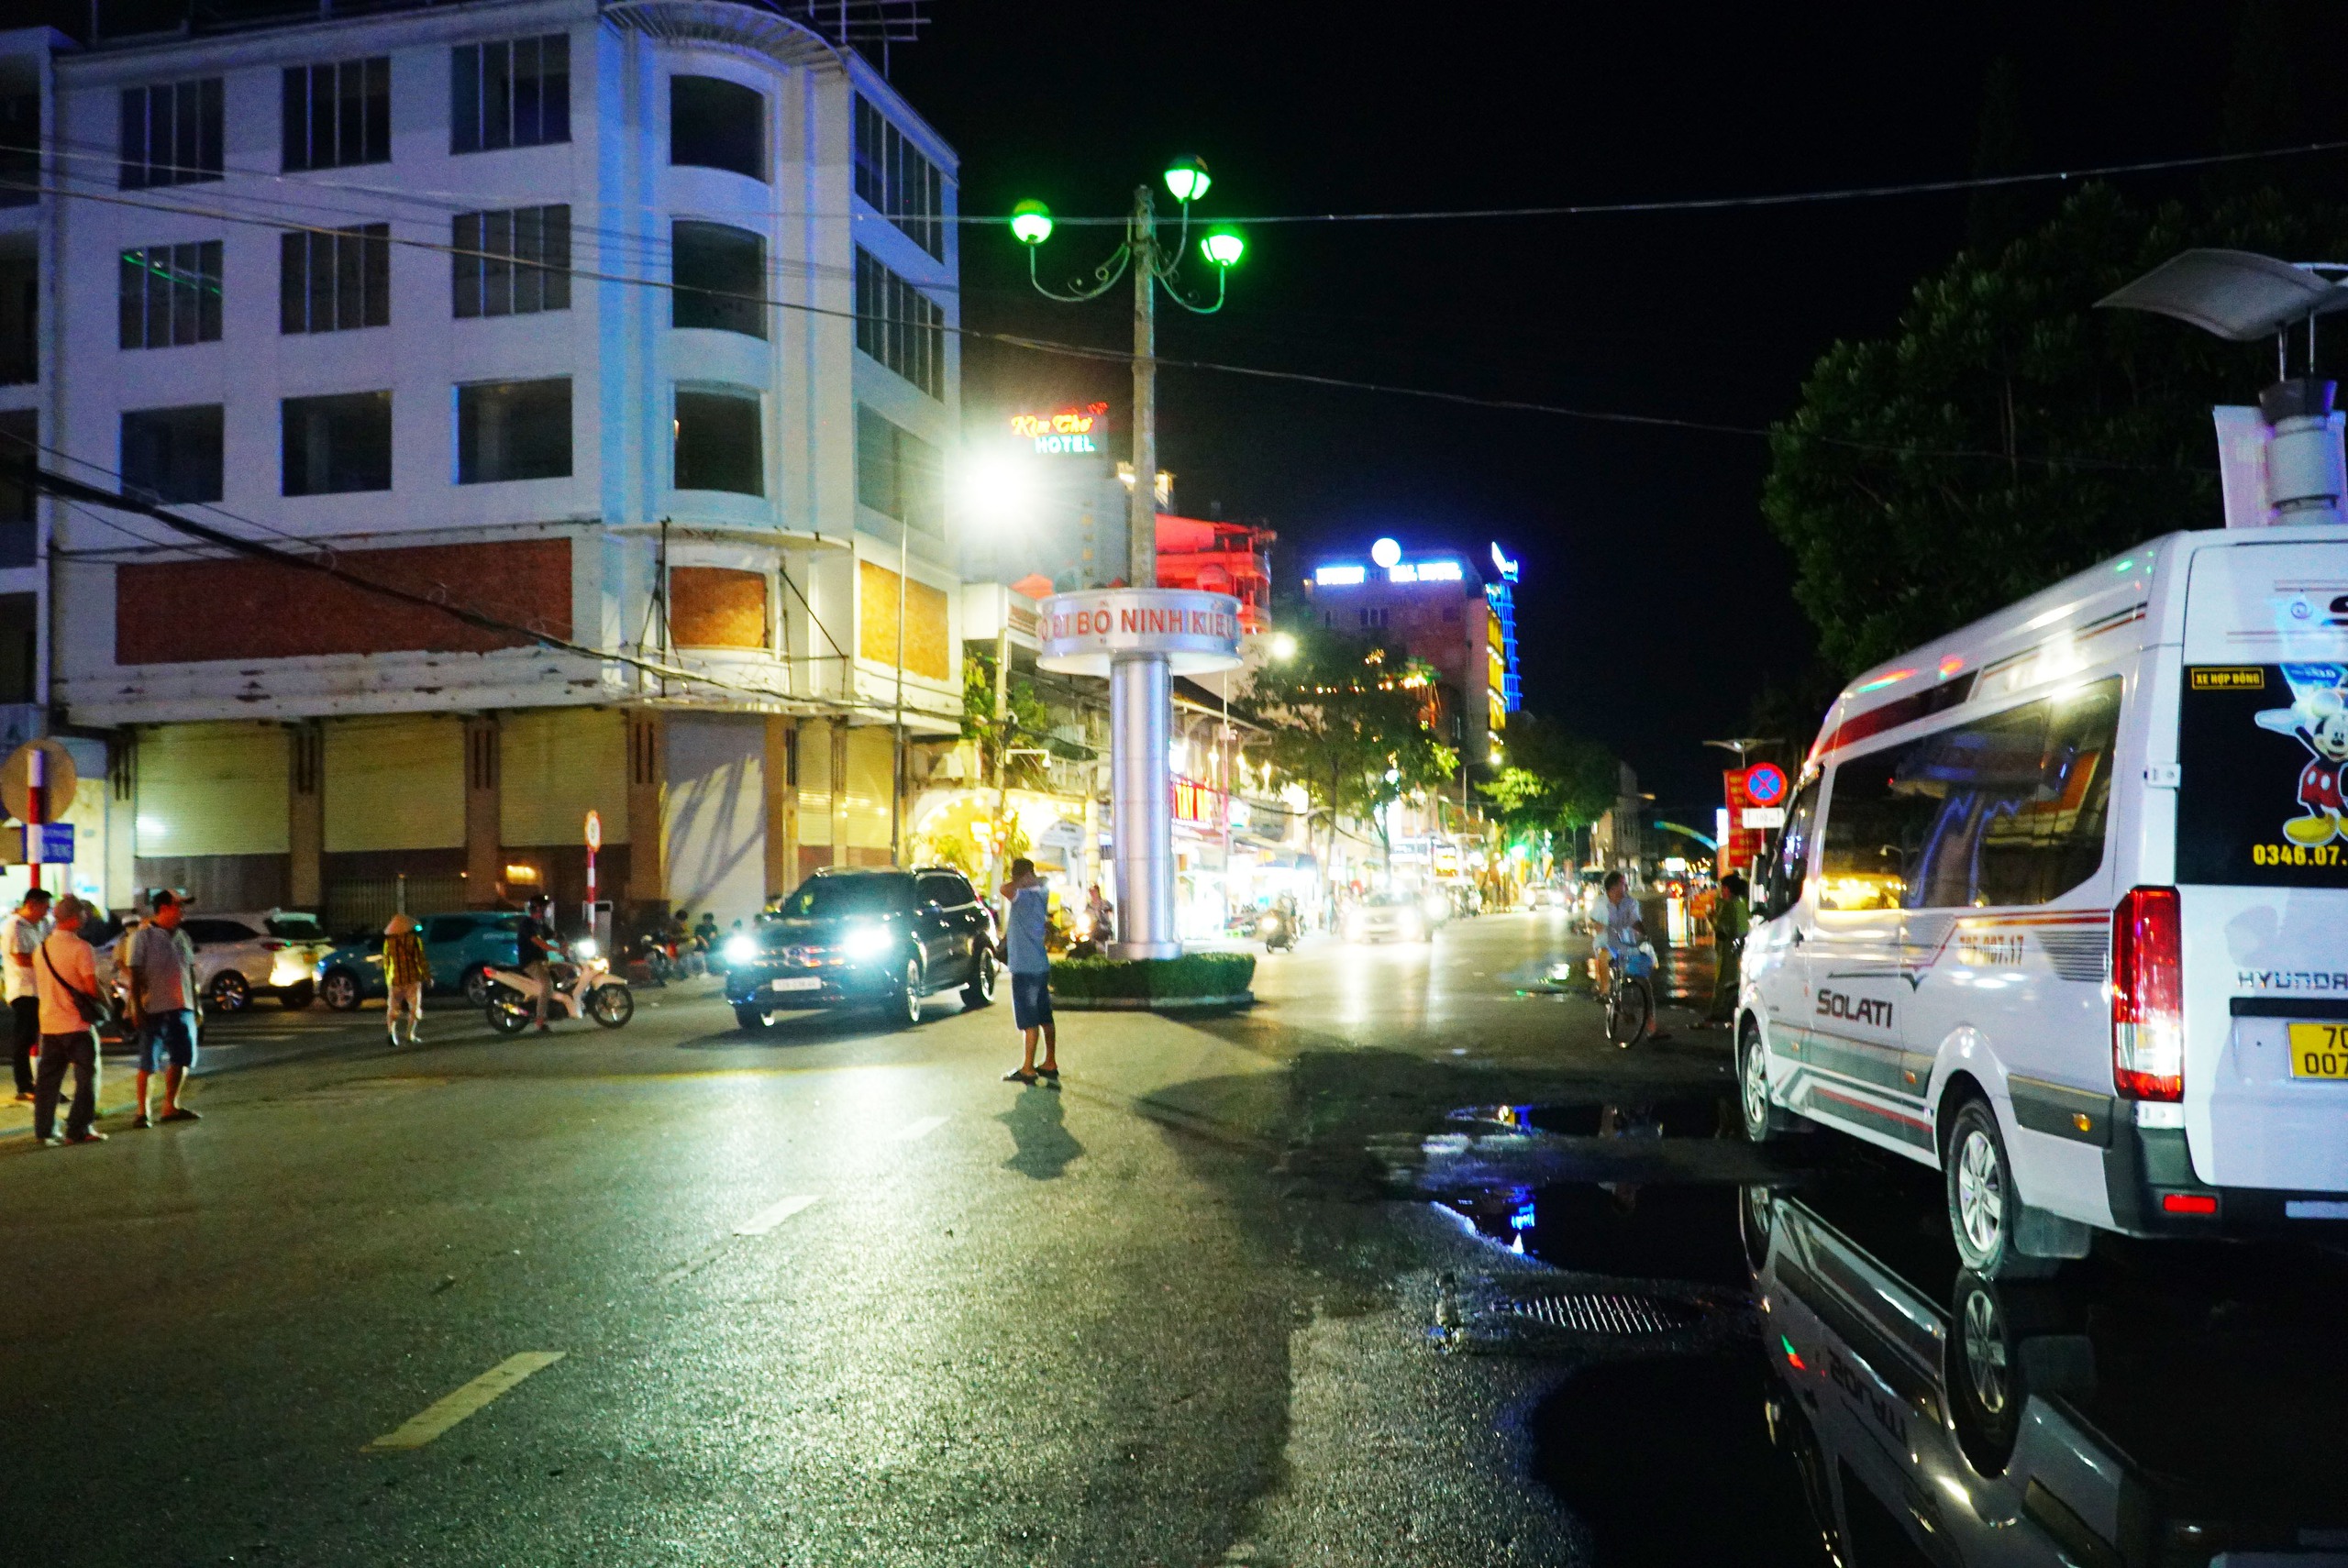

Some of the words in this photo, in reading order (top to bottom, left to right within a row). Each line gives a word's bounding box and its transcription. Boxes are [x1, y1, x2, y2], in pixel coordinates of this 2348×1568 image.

[1035, 435, 1095, 454] HOTEL
[1121, 609, 1182, 633] NINH
[2196, 673, 2209, 685] XE
[1816, 988, 1893, 1029] SOLATI
